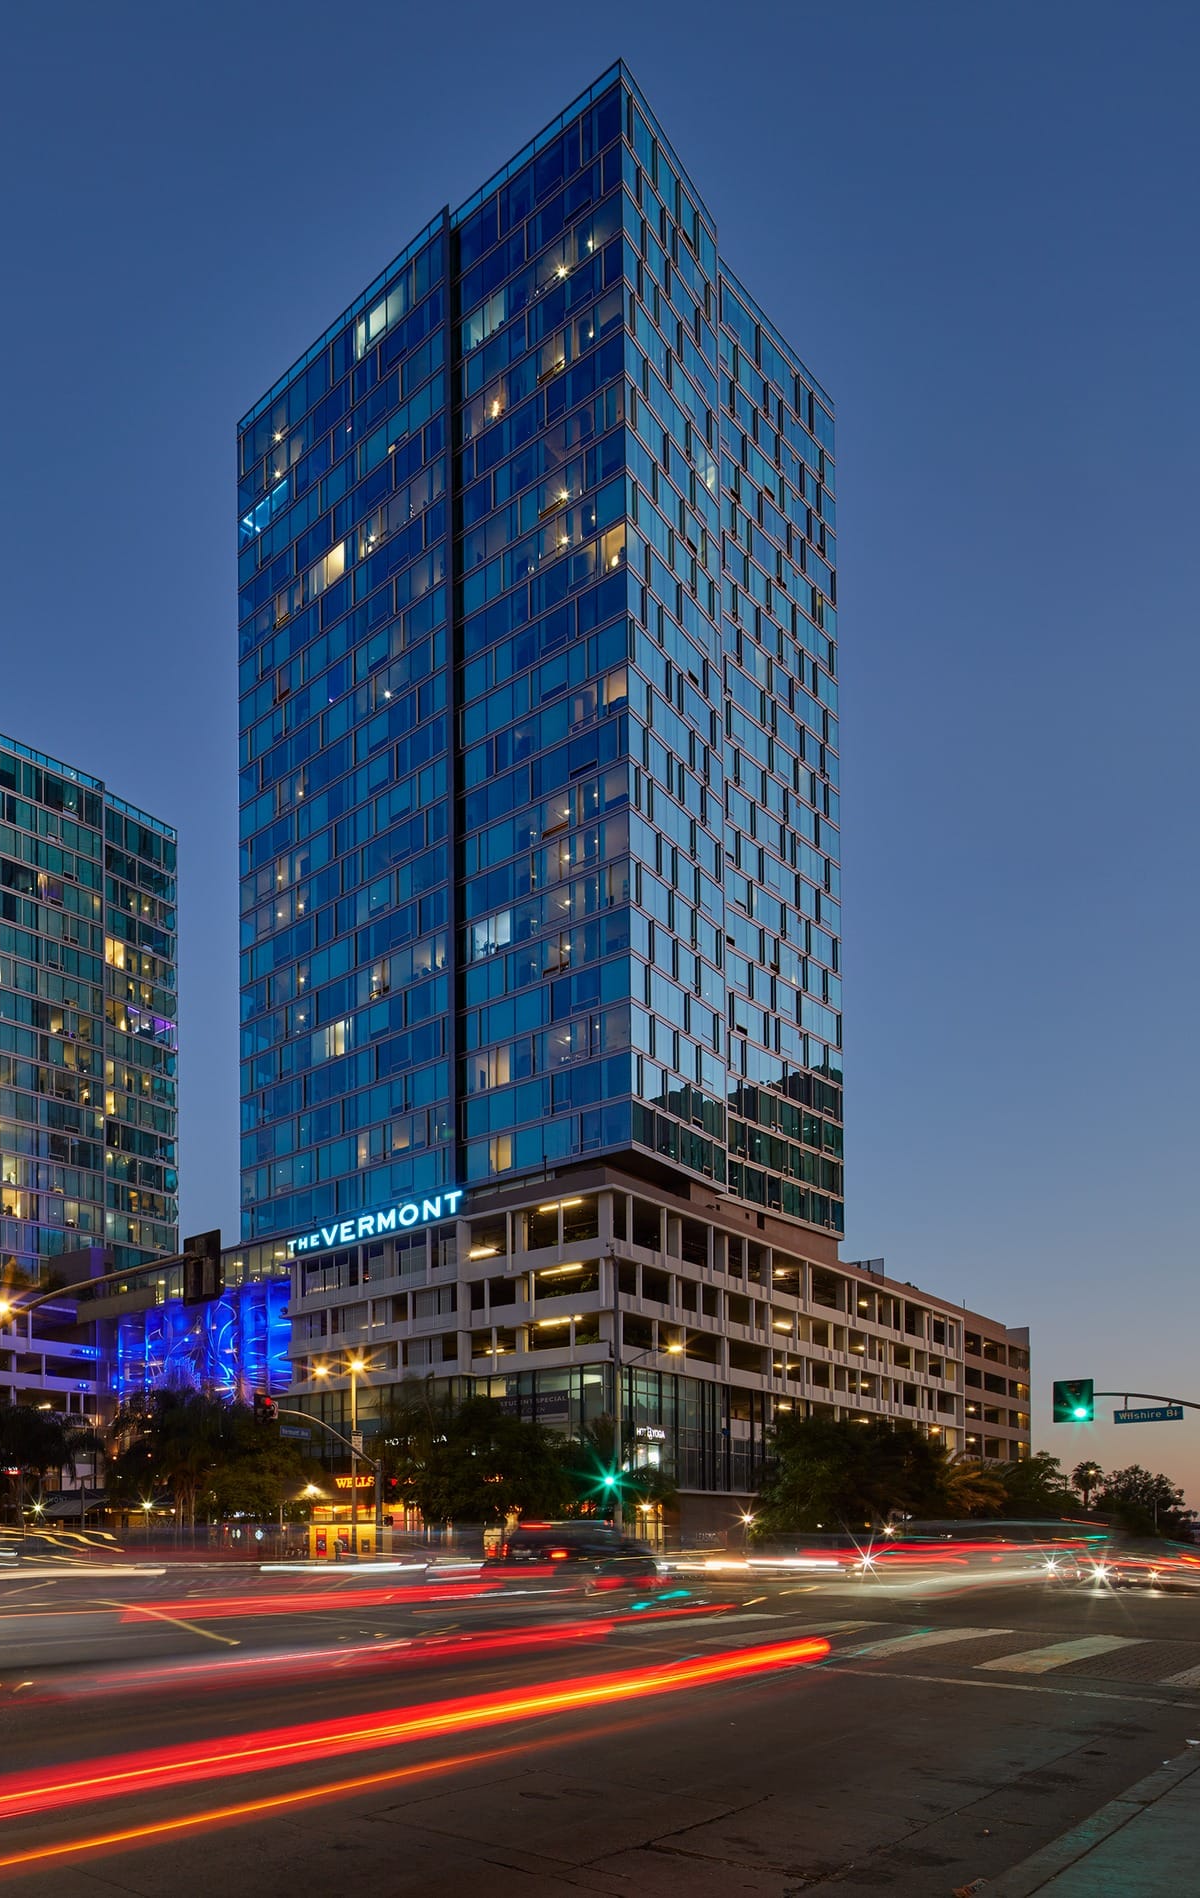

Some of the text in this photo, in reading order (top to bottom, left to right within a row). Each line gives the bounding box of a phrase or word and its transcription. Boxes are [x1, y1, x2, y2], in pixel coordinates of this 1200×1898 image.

[287, 1189, 463, 1258] THE VERMONT
[535, 1395, 567, 1404] SPECIAL
[1119, 1409, 1178, 1421] Wilshire Bl
[652, 1429, 666, 1439] YOGA
[336, 1476, 375, 1488] WELLS
